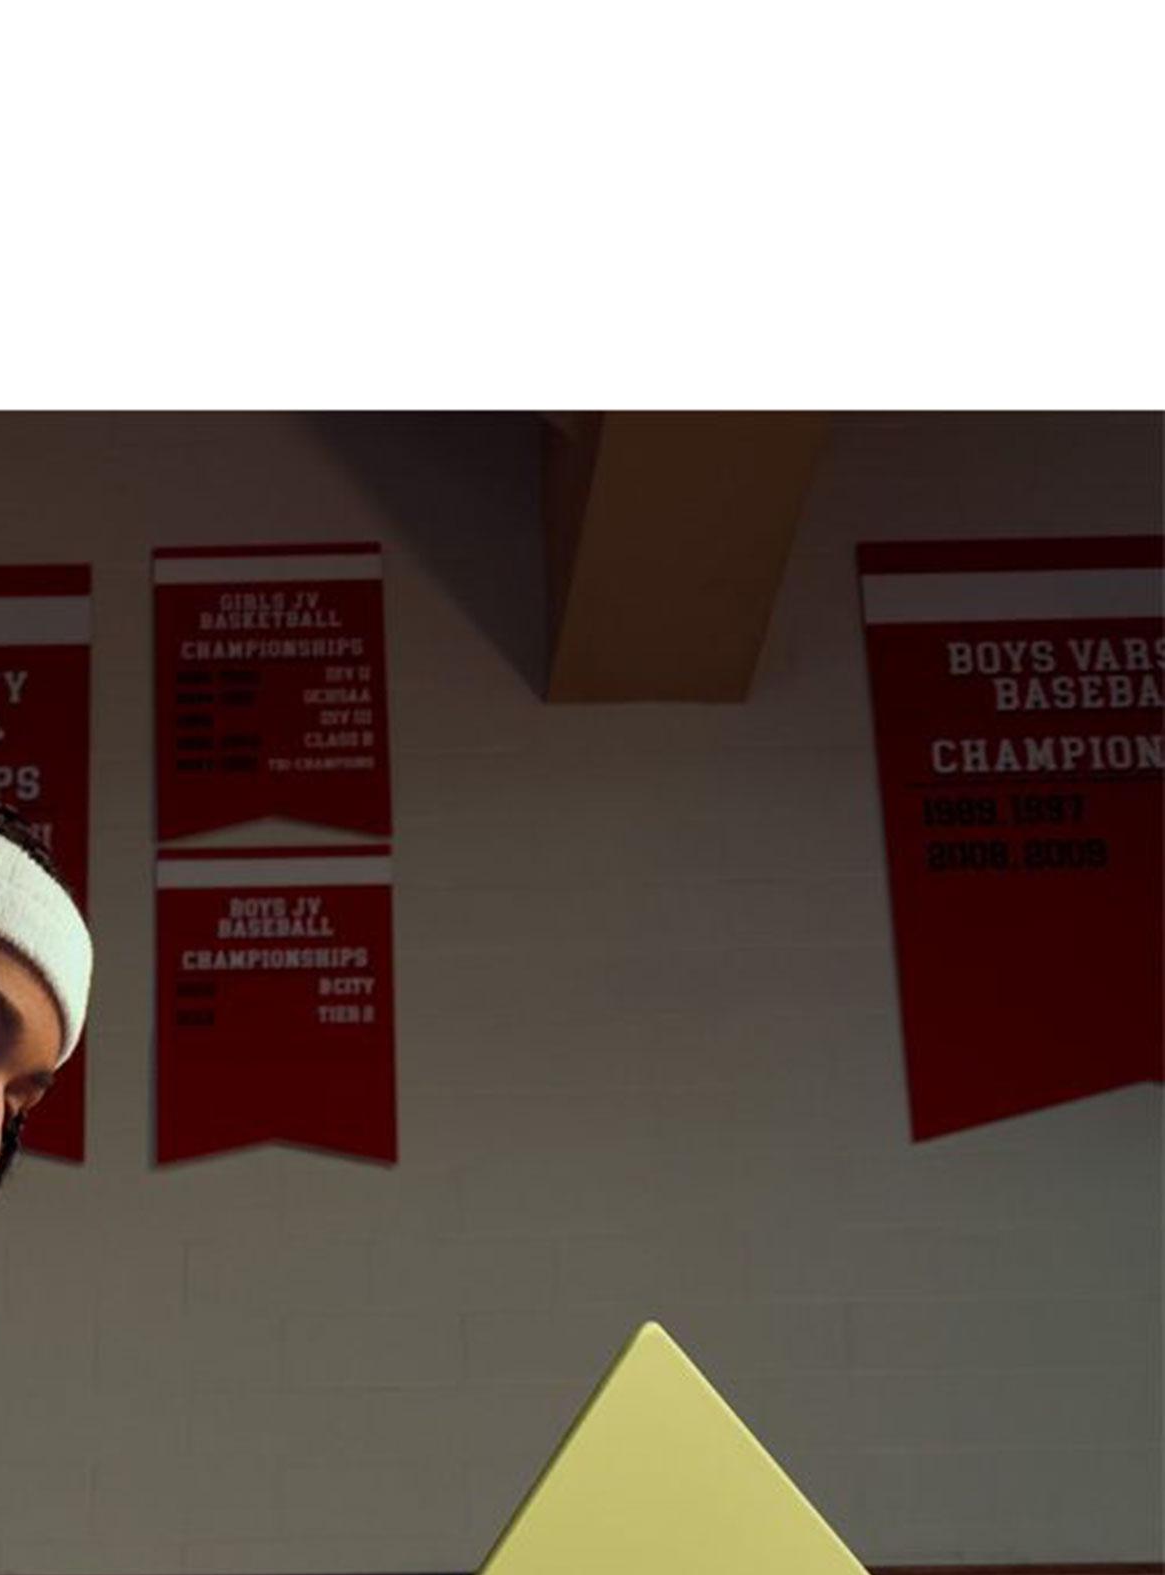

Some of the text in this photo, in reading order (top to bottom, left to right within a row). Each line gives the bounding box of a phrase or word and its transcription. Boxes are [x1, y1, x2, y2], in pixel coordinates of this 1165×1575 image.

[219, 591, 285, 611] GIRLS
[198, 609, 342, 631] BASKETBALL
[180, 637, 364, 660] CHAMPIONSHIPS
[946, 639, 1057, 676] BOYS
[993, 673, 1164, 711] BASEBA
[930, 734, 1164, 774] CHAMPION
[228, 896, 322, 917] BOYS JV
[217, 917, 334, 939] BASEBALL
[181, 948, 368, 970] CHAMPIONSHIPS
